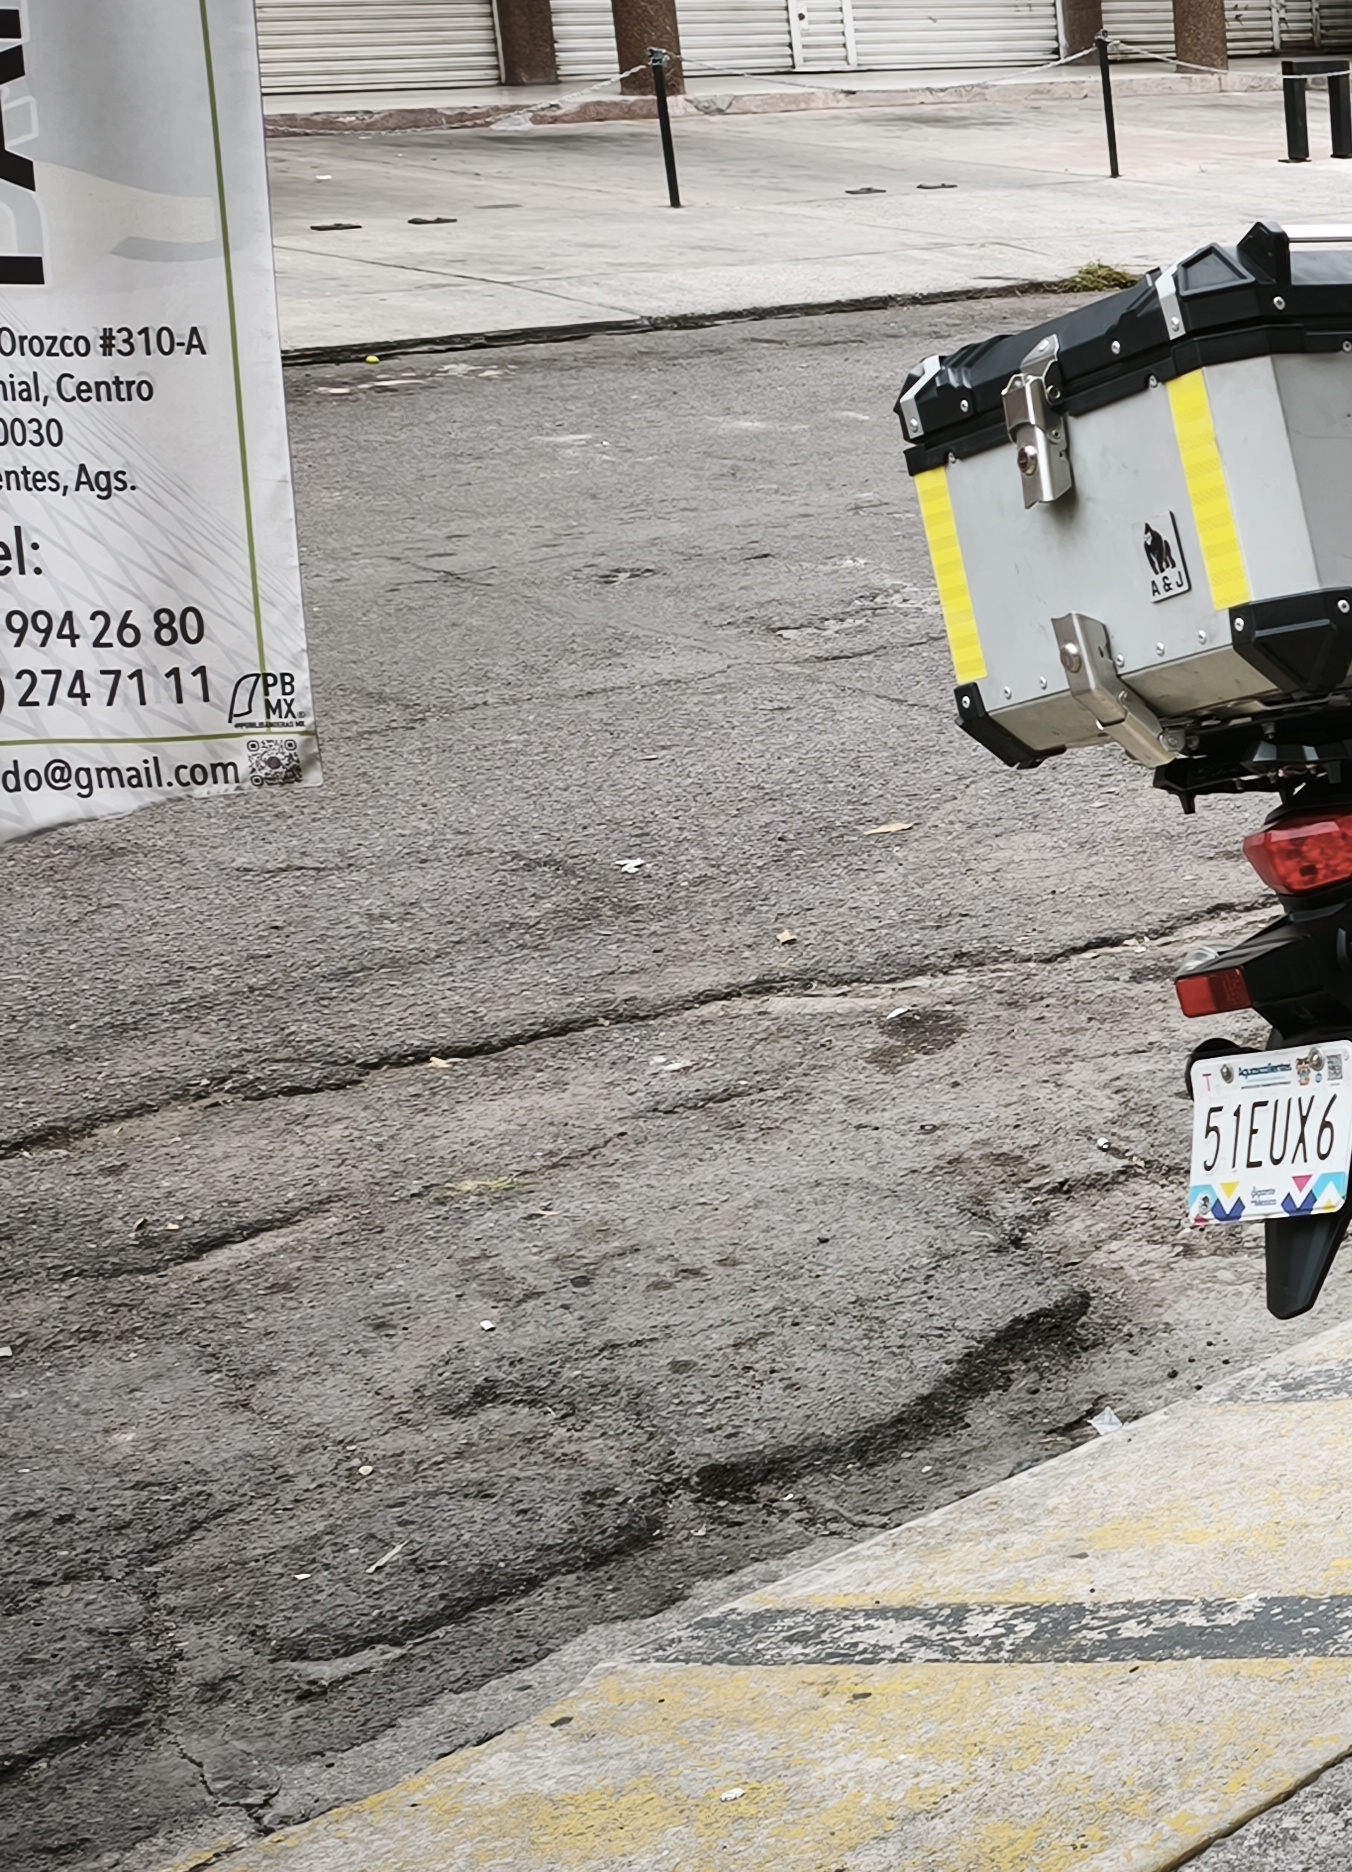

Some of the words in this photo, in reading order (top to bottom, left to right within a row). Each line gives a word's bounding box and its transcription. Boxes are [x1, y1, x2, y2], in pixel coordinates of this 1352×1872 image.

[0, 327, 91, 357] Orozco
[99, 326, 207, 356] #310-A
[56, 373, 154, 403] Centro
[0, 465, 69, 497] ntes,
[74, 463, 137, 501] Ags.
[5, 609, 81, 648] 994
[89, 609, 142, 649] 26
[153, 606, 205, 647] 80
[15, 668, 92, 707] 274
[99, 668, 147, 707] 71
[164, 665, 211, 705] 11
[262, 672, 295, 697] PB
[264, 698, 297, 720] MX
[1, 756, 241, 799] do@gmail.com
[1203, 1094, 1337, 1172] 51EUX6
